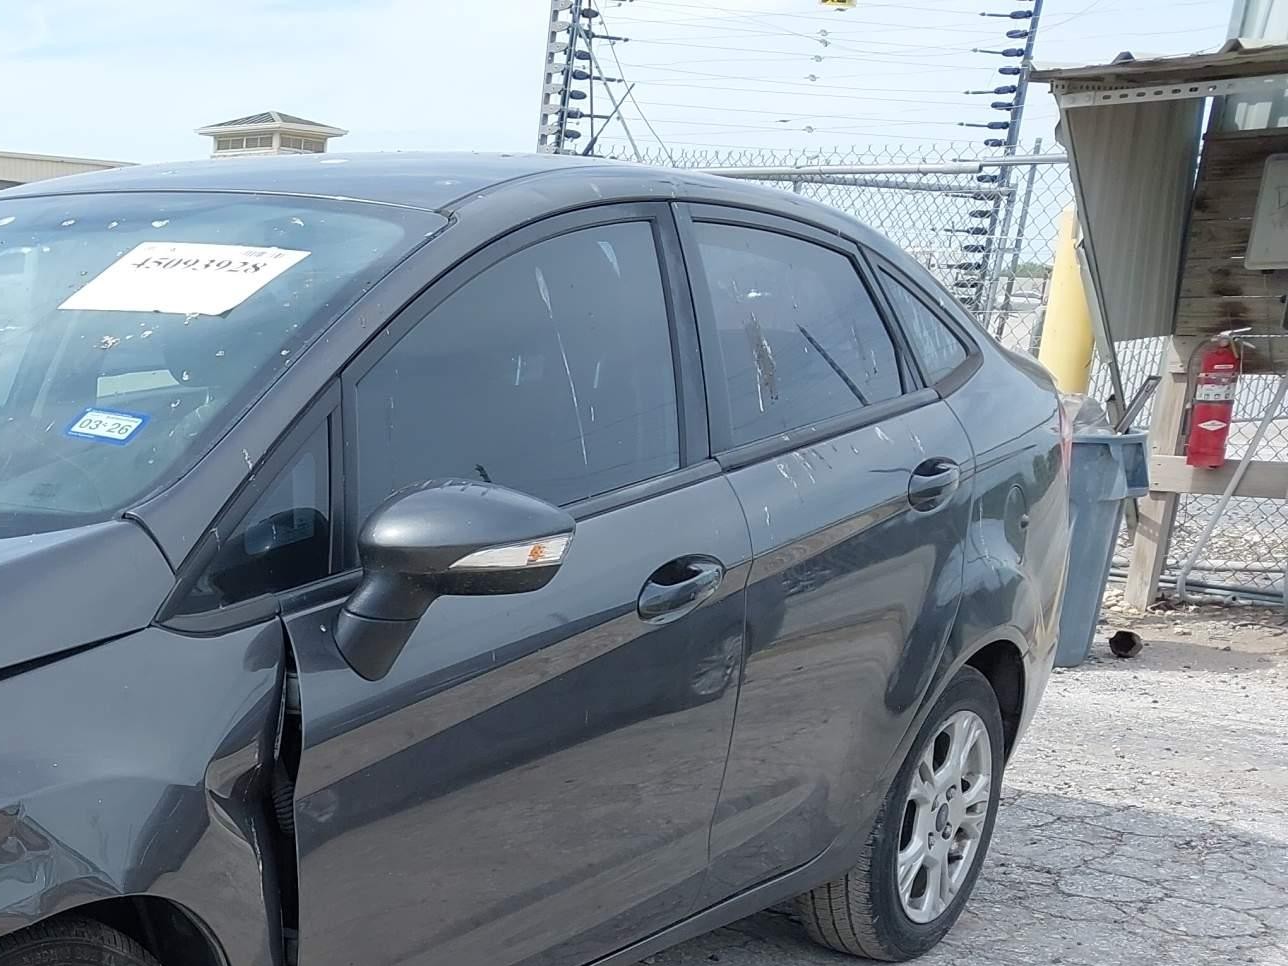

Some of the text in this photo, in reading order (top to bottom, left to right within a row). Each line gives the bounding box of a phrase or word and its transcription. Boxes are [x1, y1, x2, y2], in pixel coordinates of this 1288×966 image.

[131, 256, 268, 274] 45093928
[79, 418, 103, 431] 03
[106, 422, 132, 435] 26
